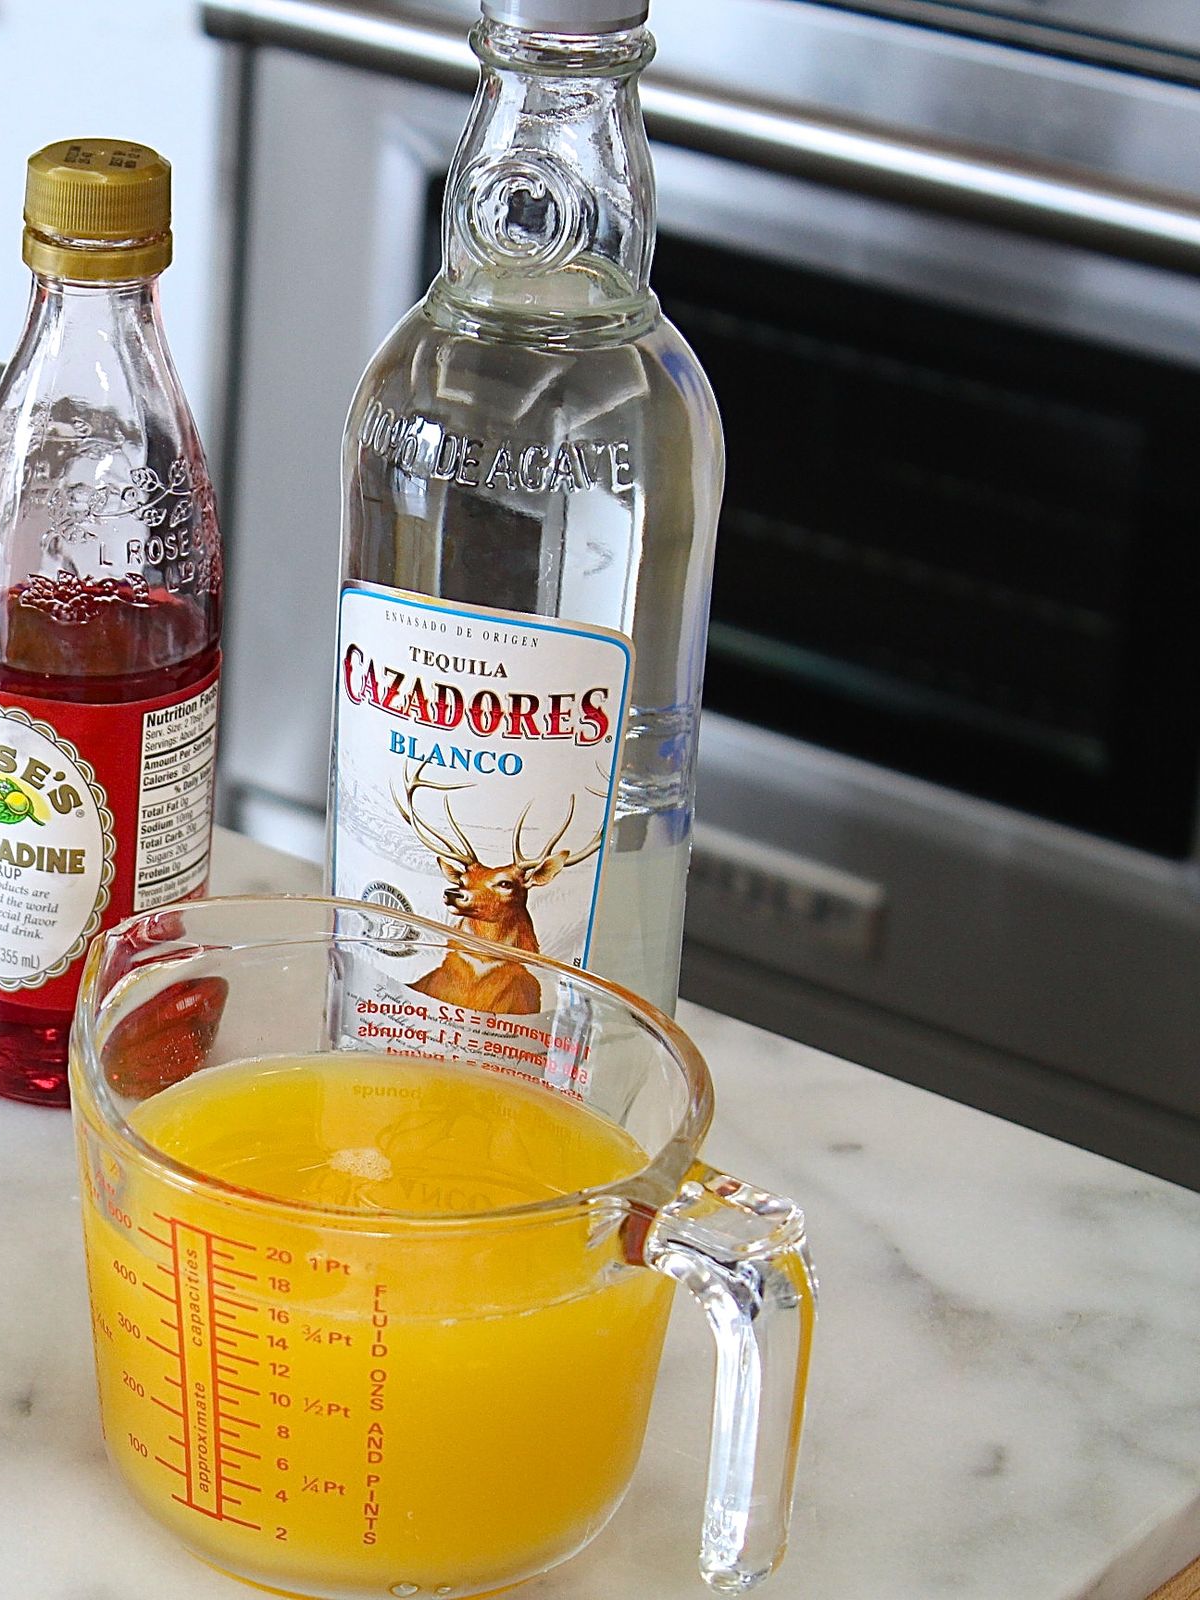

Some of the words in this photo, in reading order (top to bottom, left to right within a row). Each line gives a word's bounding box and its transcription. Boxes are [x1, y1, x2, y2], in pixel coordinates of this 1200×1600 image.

[431, 433, 484, 487] DE
[486, 439, 635, 494] AGAVE
[126, 528, 190, 566] ROSE
[385, 610, 447, 633] ENVASADO
[456, 625, 472, 639] DE
[482, 630, 539, 648] ORIGEN
[408, 645, 508, 679] TEQUILA
[343, 643, 611, 746] CAZADORES
[147, 701, 197, 727] Nutrition
[144, 754, 177, 770] Amount
[180, 749, 191, 760] Per
[389, 729, 523, 776] BLANCO
[143, 771, 178, 786] Calories
[141, 806, 164, 819] Total
[167, 800, 178, 812] Fat
[141, 820, 173, 835] Sodium
[140, 838, 162, 850] Total
[146, 849, 173, 864] Sugars
[138, 865, 170, 881] Protein
[32, 888, 51, 899] are
[7, 897, 23, 908] the
[26, 902, 59, 914] world
[22, 912, 57, 927] flavor
[11, 926, 44, 940] drink.
[21, 954, 40, 970] mL)
[266, 1247, 292, 1264] 20
[113, 1260, 137, 1285] 400
[310, 1257, 318, 1271] 1
[326, 1260, 351, 1275] Pt
[268, 1277, 290, 1293] 18
[187, 1248, 205, 1347] capacities
[268, 1308, 290, 1324] 16
[371, 1284, 388, 1357] FLUID
[117, 1311, 141, 1339] 300
[267, 1335, 289, 1351] 14
[328, 1332, 352, 1347] Pt
[269, 1362, 290, 1378] 12
[122, 1370, 145, 1398] 200
[370, 1369, 387, 1411] OZS
[269, 1392, 291, 1408] 10
[327, 1403, 351, 1418] Pt
[194, 1382, 210, 1493] approximate
[277, 1425, 290, 1439] 8
[128, 1432, 148, 1458] 100
[367, 1422, 384, 1464] AND
[277, 1458, 289, 1471] 6
[275, 1490, 288, 1503] 4
[324, 1481, 346, 1495] Pt
[363, 1475, 380, 1545] PINTS
[276, 1527, 288, 1541] 2
